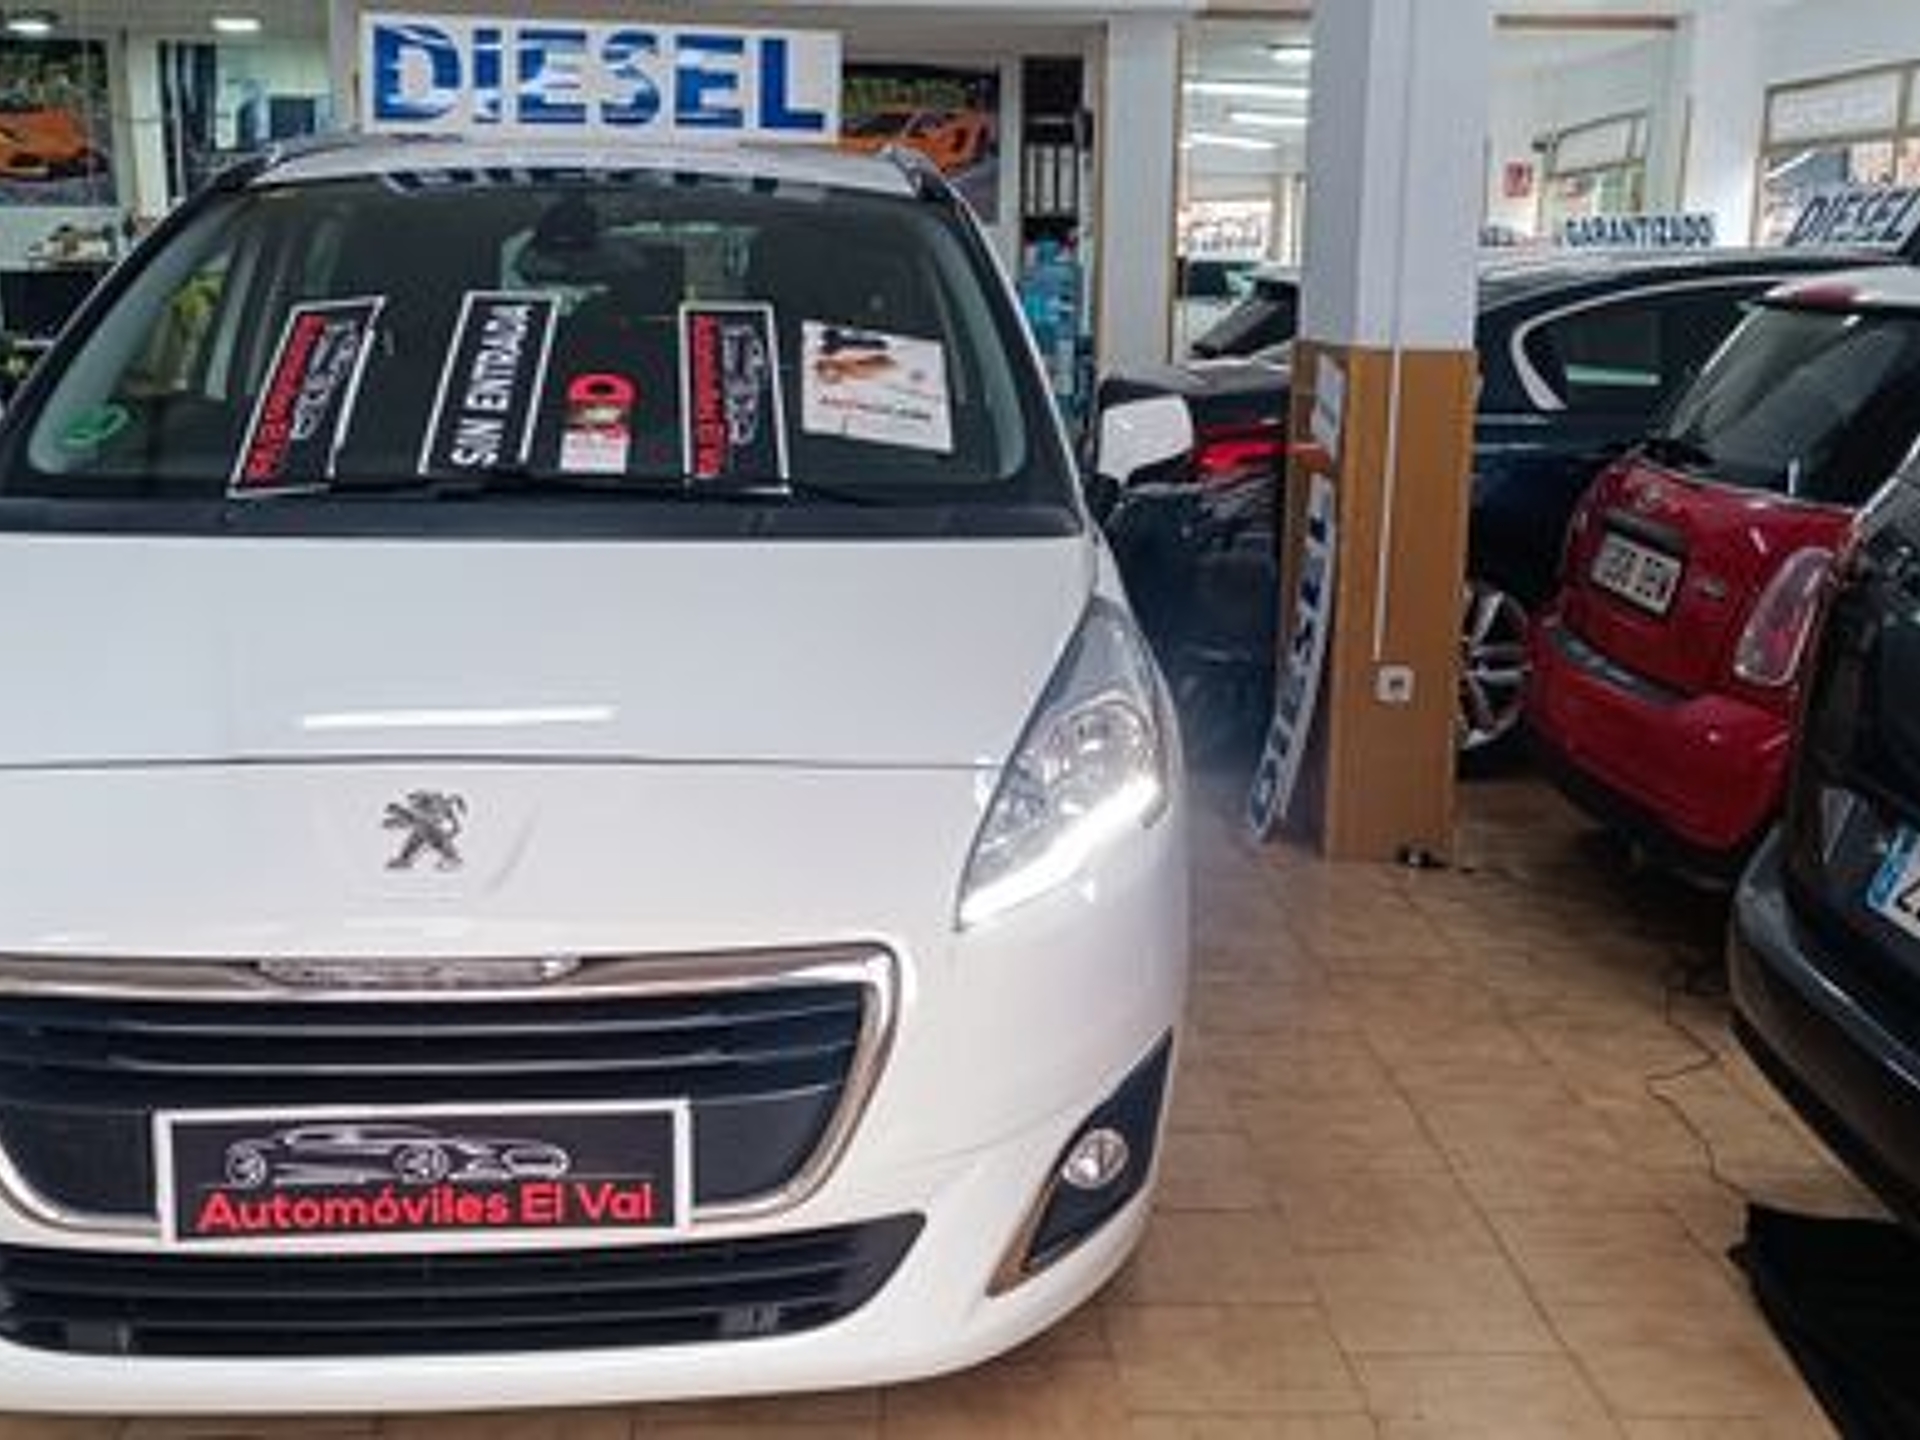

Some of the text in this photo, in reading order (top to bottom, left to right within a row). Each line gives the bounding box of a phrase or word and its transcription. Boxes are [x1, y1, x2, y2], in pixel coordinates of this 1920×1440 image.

[373, 24, 826, 130] DIESEL
[1566, 216, 1715, 247] GARANTIZADO
[451, 304, 533, 467] SIN ENTRADA
[198, 1183, 654, 1232] Automóviles El Val
